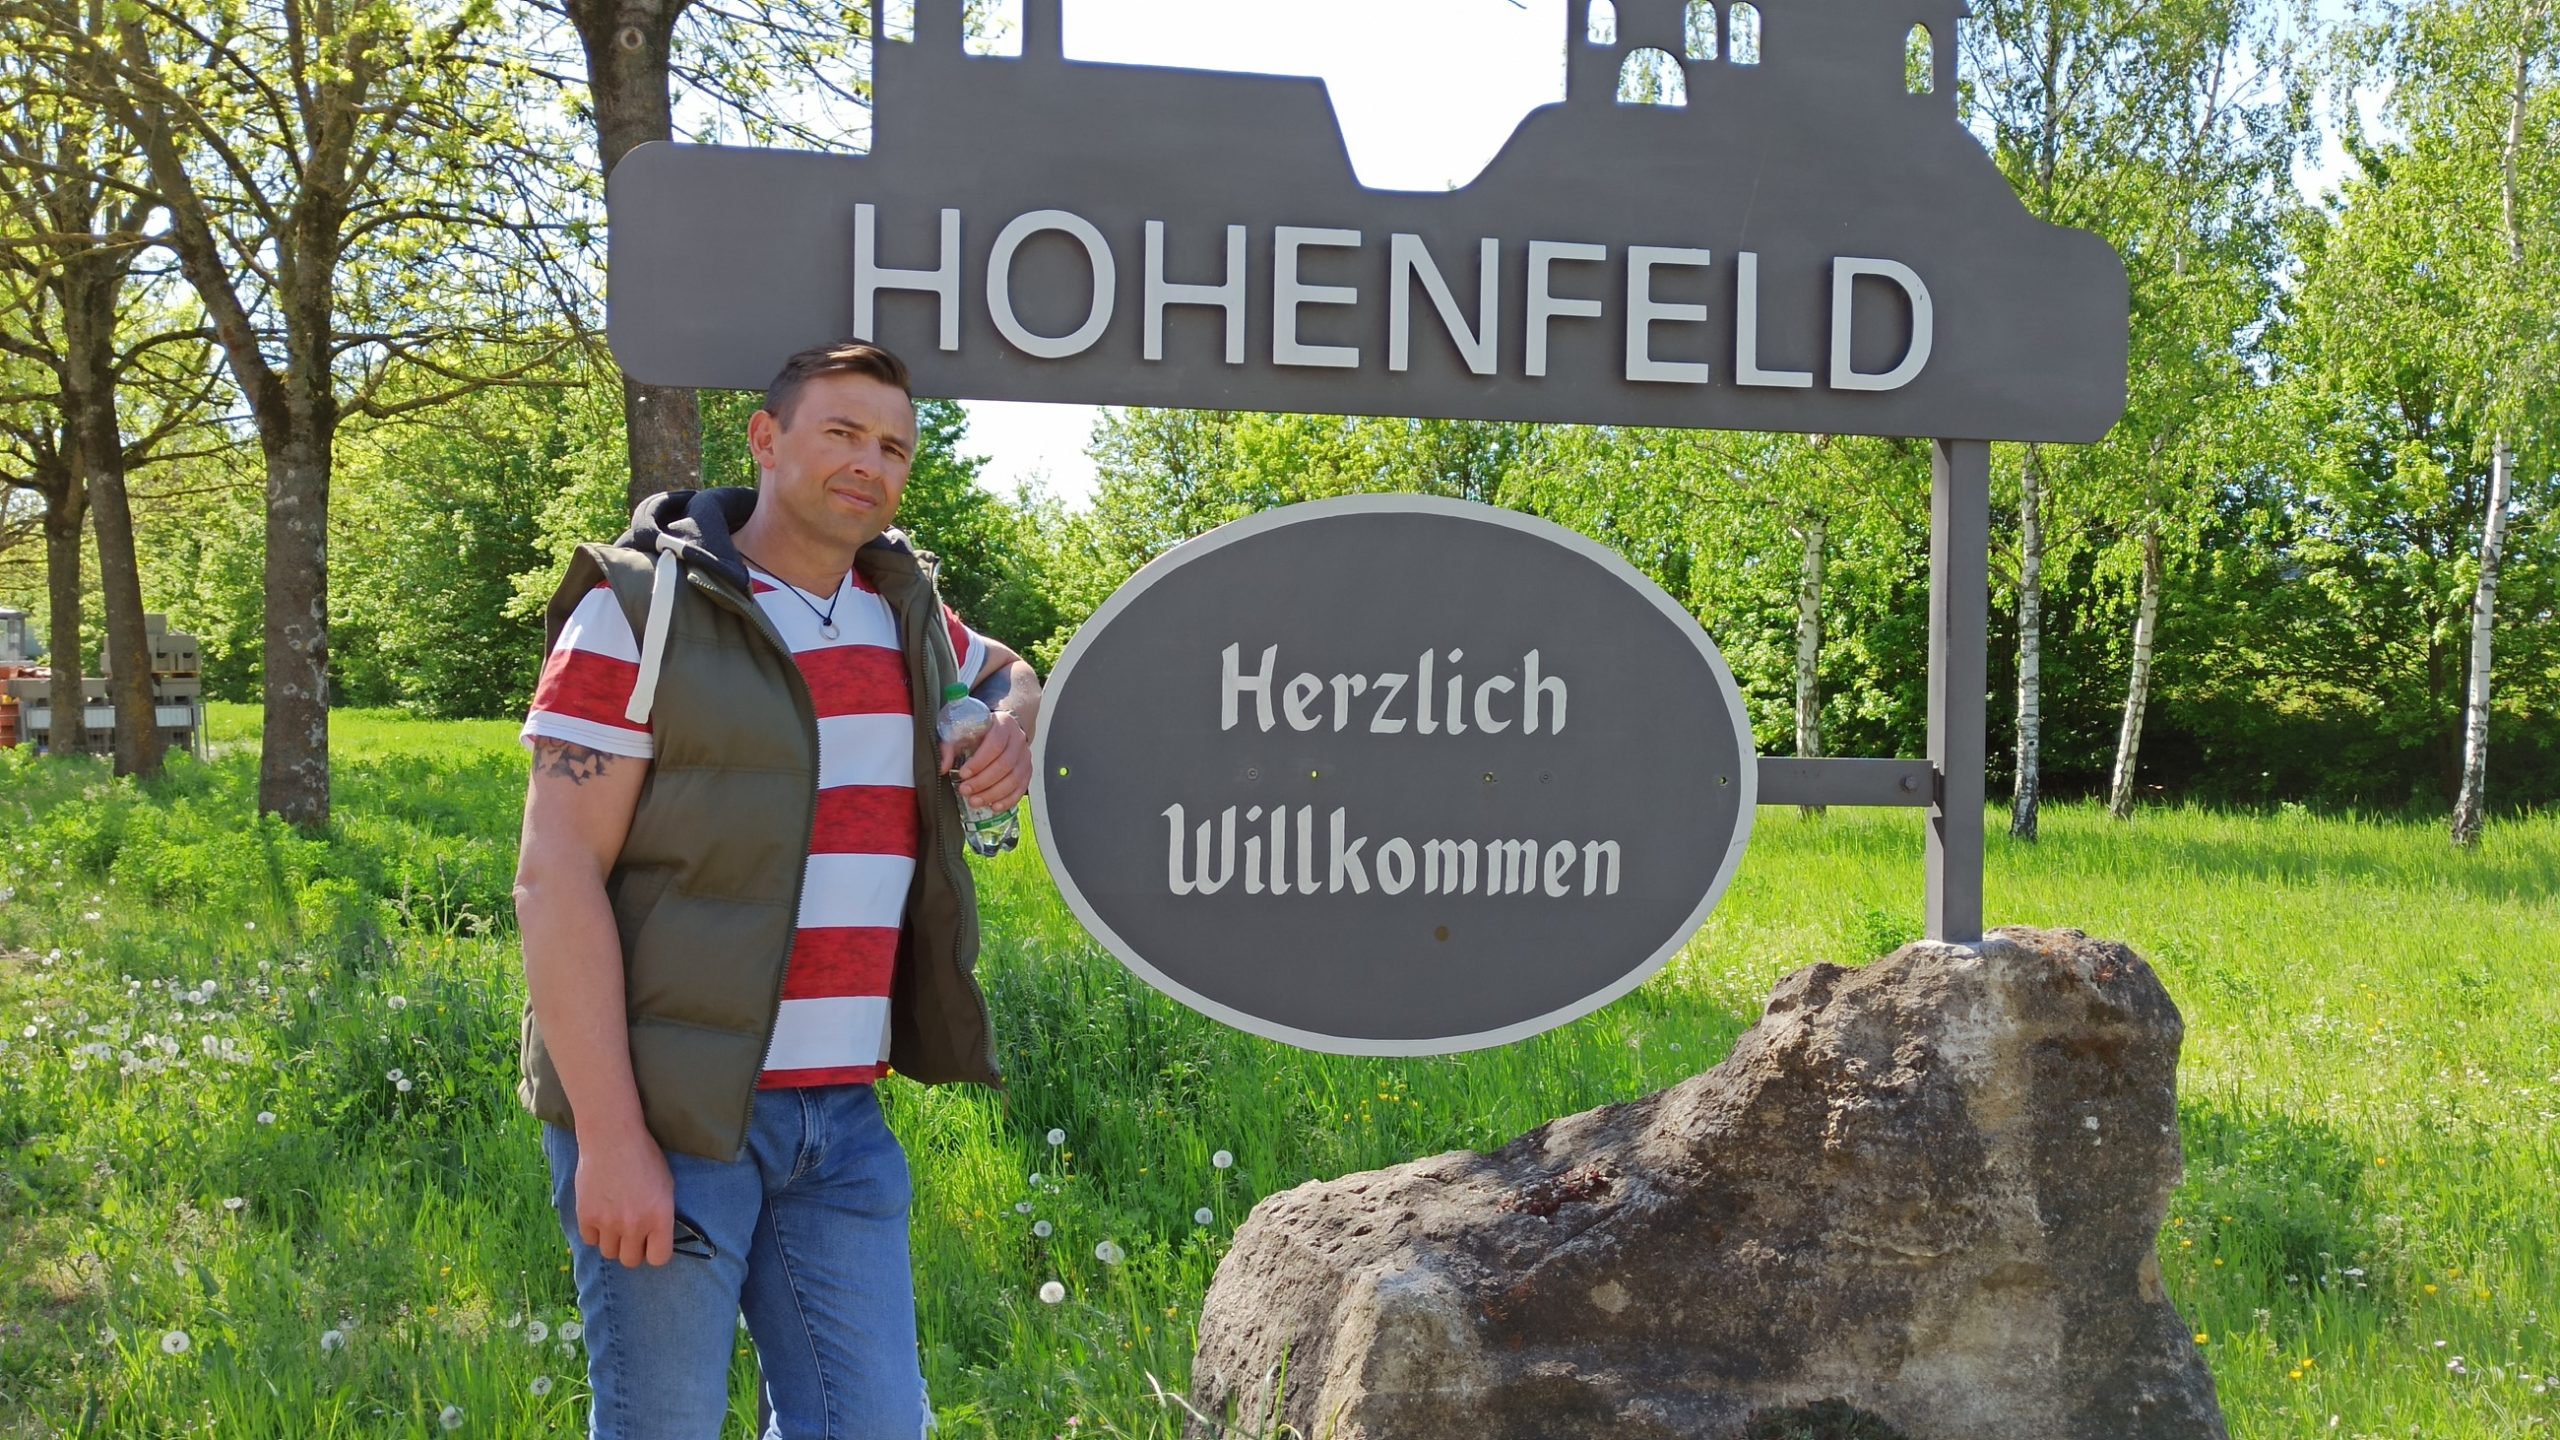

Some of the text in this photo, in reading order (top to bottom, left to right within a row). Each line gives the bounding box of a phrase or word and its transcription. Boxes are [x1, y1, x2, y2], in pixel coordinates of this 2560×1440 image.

[853, 203, 1934, 391] HOHENFELD
[1221, 641, 1568, 736] Herzlich
[1160, 802, 1621, 898] Willkommen
